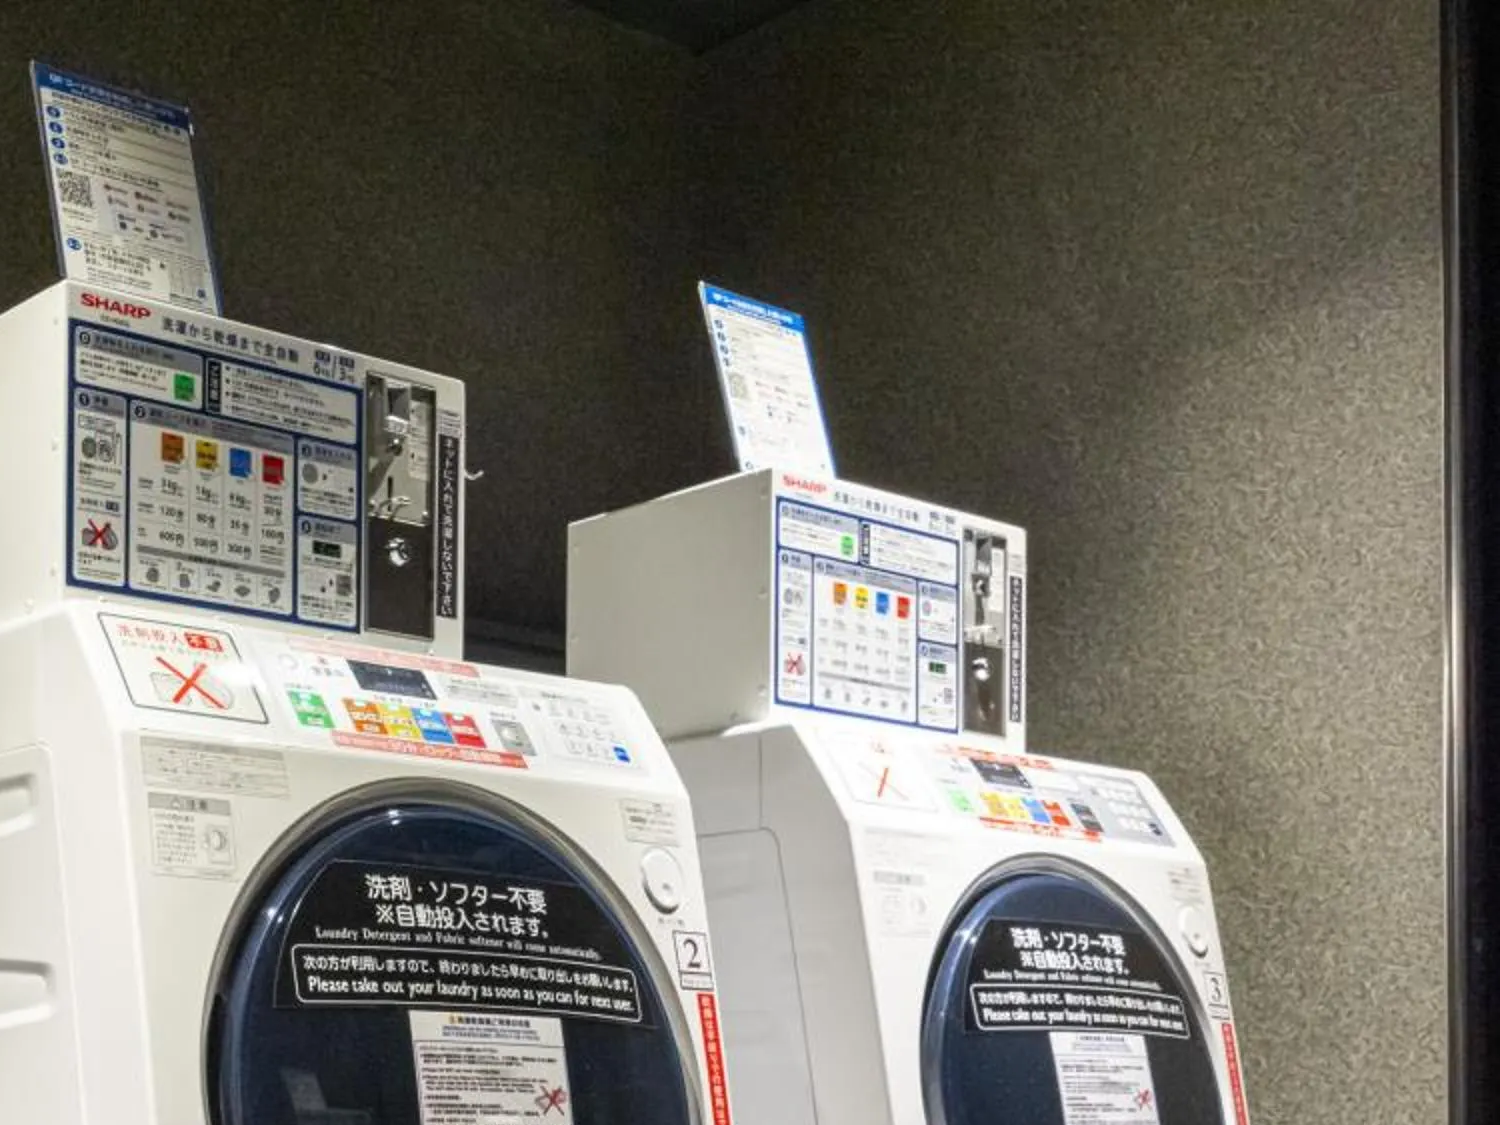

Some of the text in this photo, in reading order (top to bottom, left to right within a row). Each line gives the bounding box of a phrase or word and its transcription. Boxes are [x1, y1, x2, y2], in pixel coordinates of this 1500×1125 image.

[81, 292, 151, 319] SHARP
[365, 873, 547, 915] 洗剤・ソフター不要
[376, 903, 549, 939] ※自動投入されます。
[683, 939, 702, 968] 2
[308, 976, 349, 993] Please
[351, 977, 379, 993] take
[383, 980, 404, 993] out
[408, 982, 434, 999] your
[437, 979, 479, 1001] laundry
[481, 986, 493, 997] as
[495, 986, 521, 999] soon
[523, 988, 535, 1000] as
[536, 990, 555, 1005] you
[555, 990, 573, 1004] can
[574, 990, 589, 1007] for
[591, 995, 612, 1009] next
[1210, 976, 1221, 1002] 3
